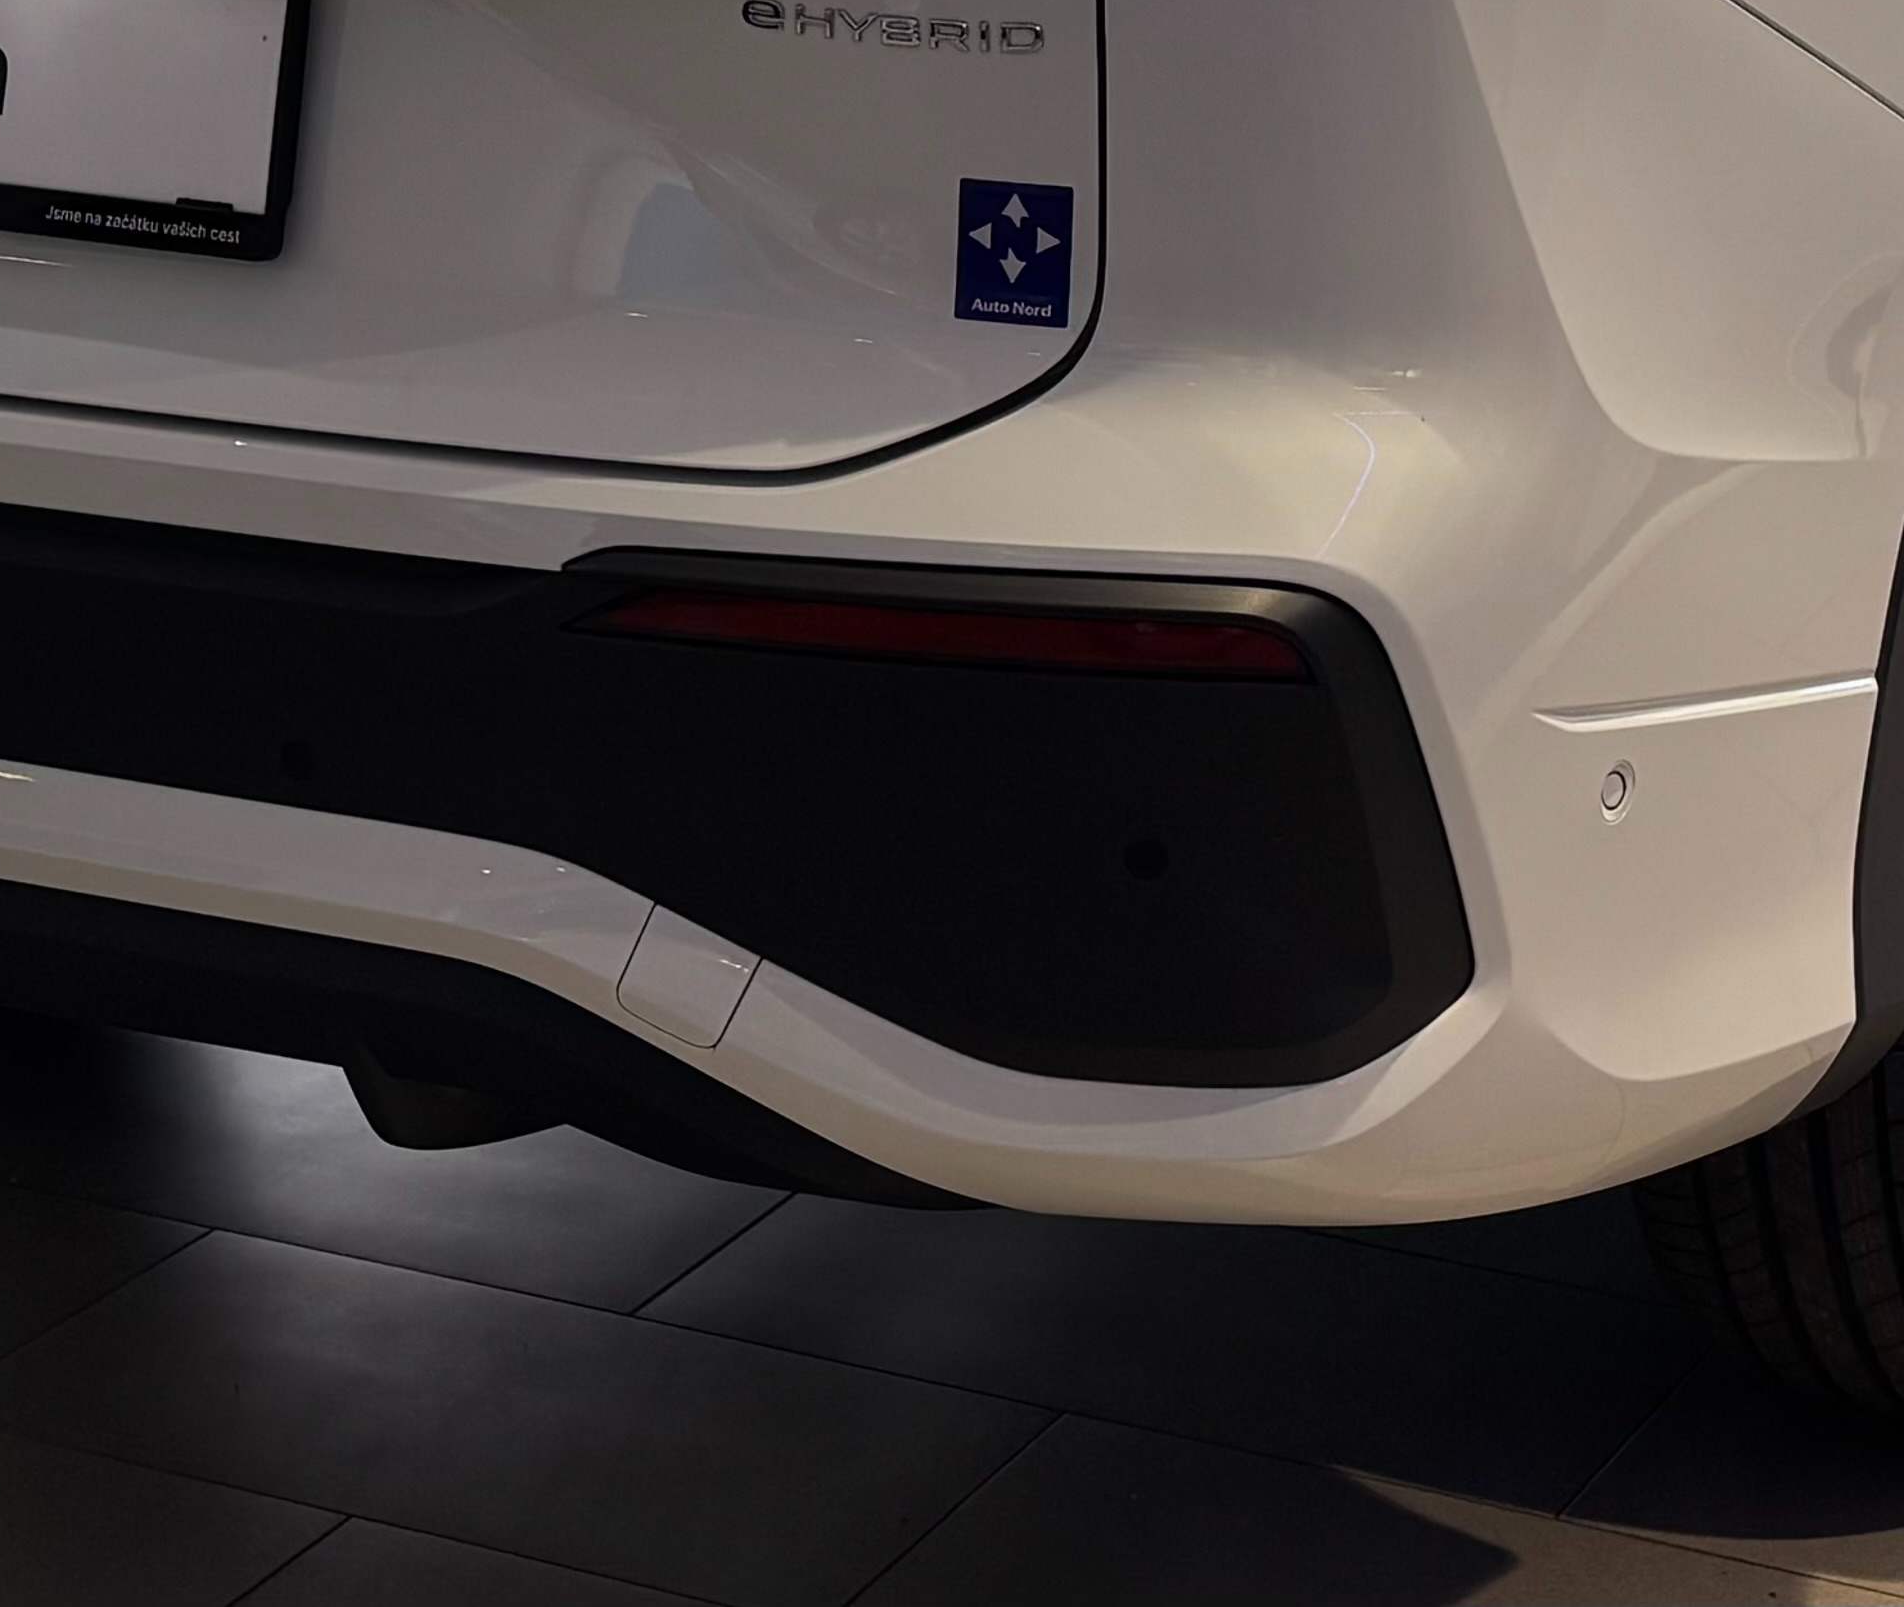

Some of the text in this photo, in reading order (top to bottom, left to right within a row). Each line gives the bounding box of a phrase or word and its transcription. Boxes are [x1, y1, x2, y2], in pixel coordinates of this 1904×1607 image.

[45, 205, 82, 223] Jsme
[85, 212, 101, 226] na
[210, 228, 240, 244] cest
[971, 297, 1052, 317] Auto Nord
